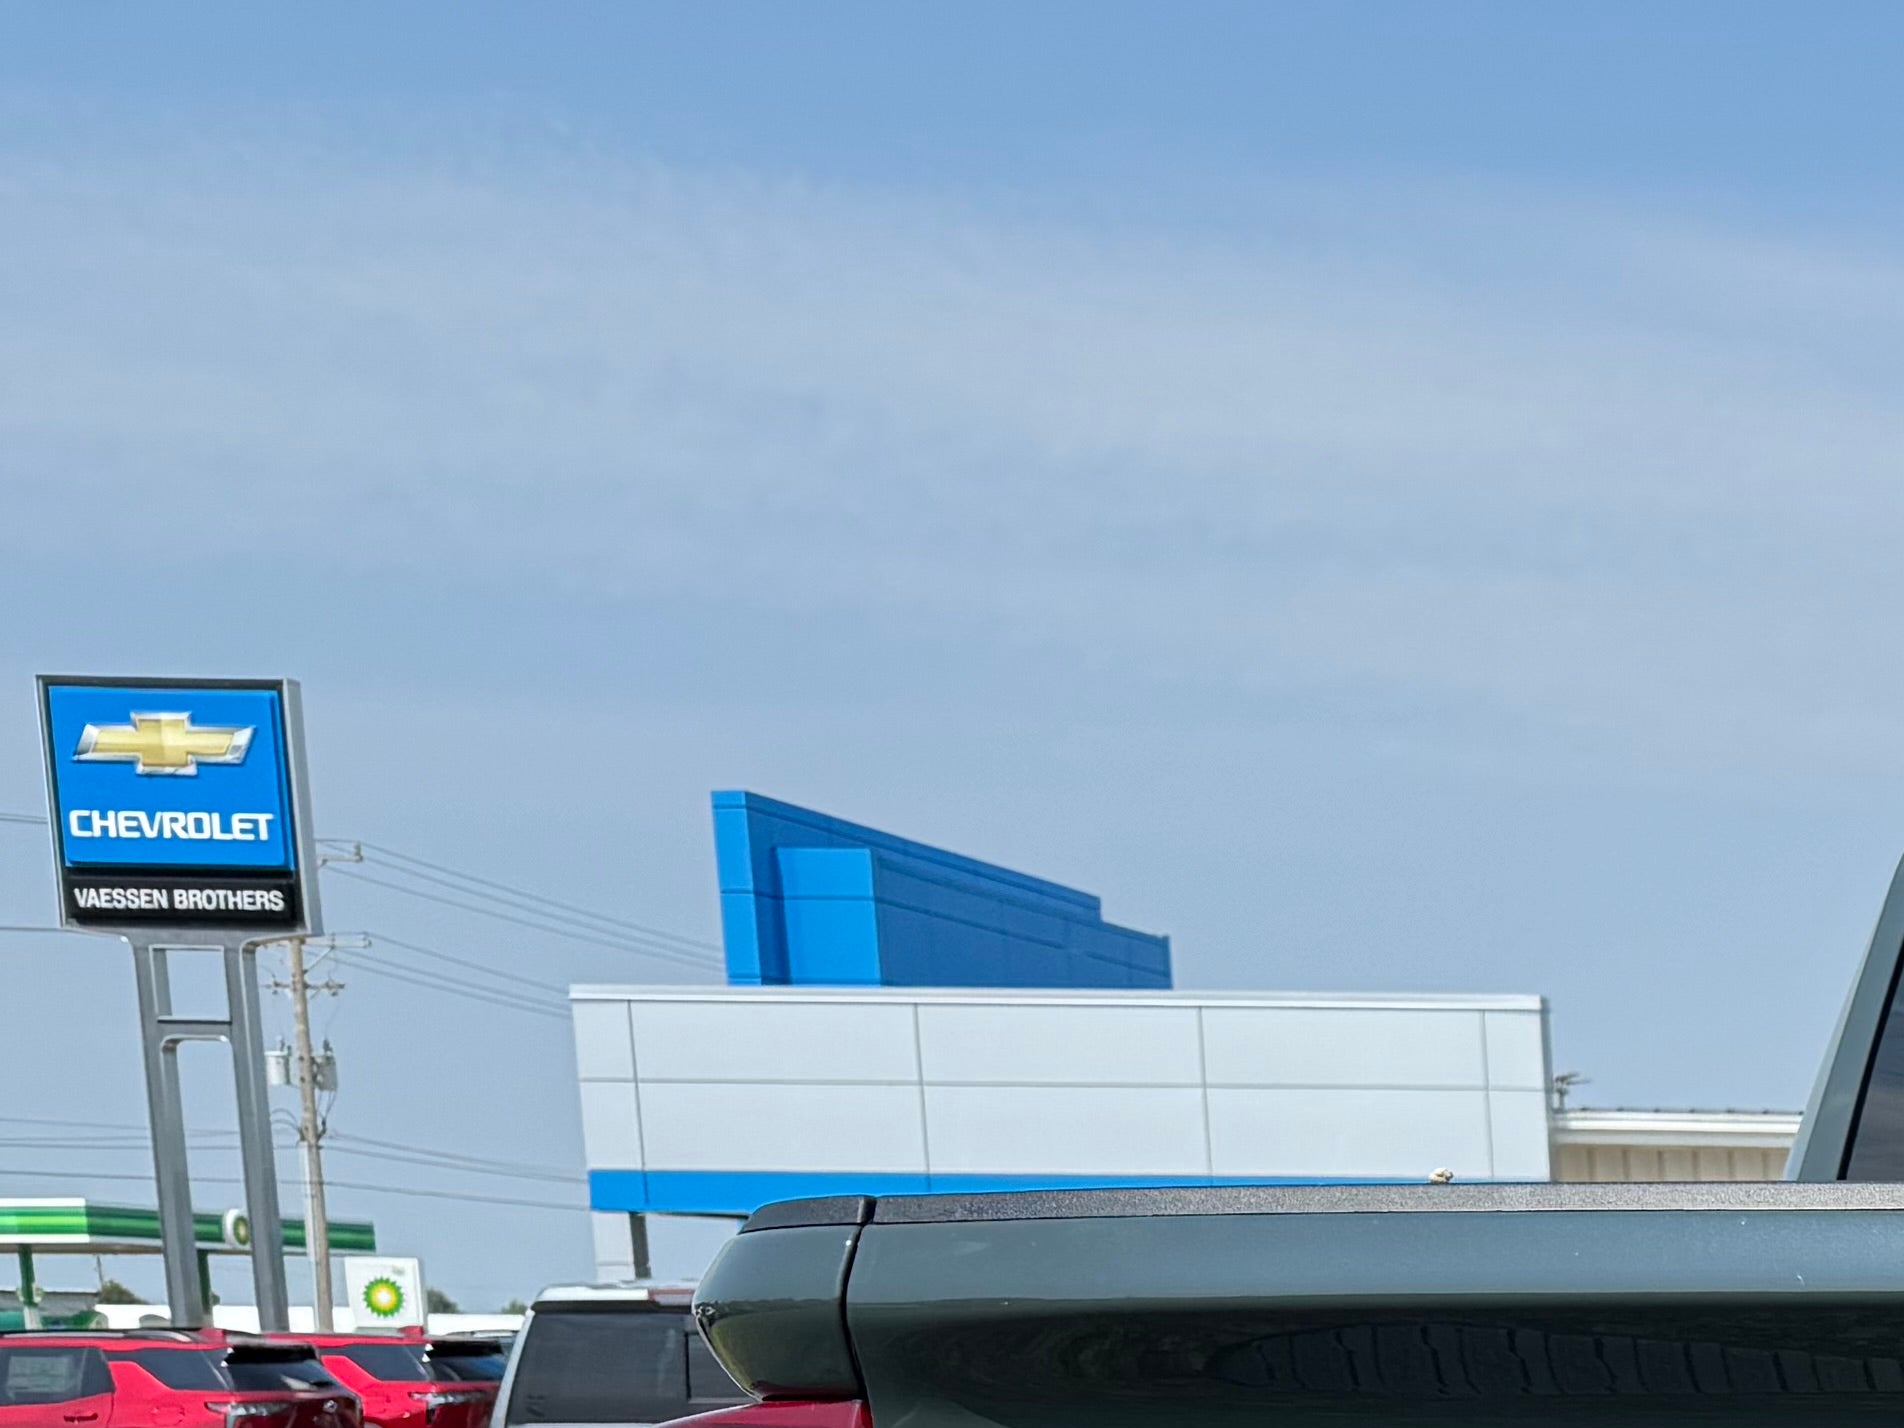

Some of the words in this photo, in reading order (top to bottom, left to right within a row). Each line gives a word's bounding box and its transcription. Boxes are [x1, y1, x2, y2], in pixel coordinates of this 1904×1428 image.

[69, 809, 275, 841] CHEVROLET
[74, 887, 169, 910] VAESSEN
[174, 888, 285, 912] BROTHERS
